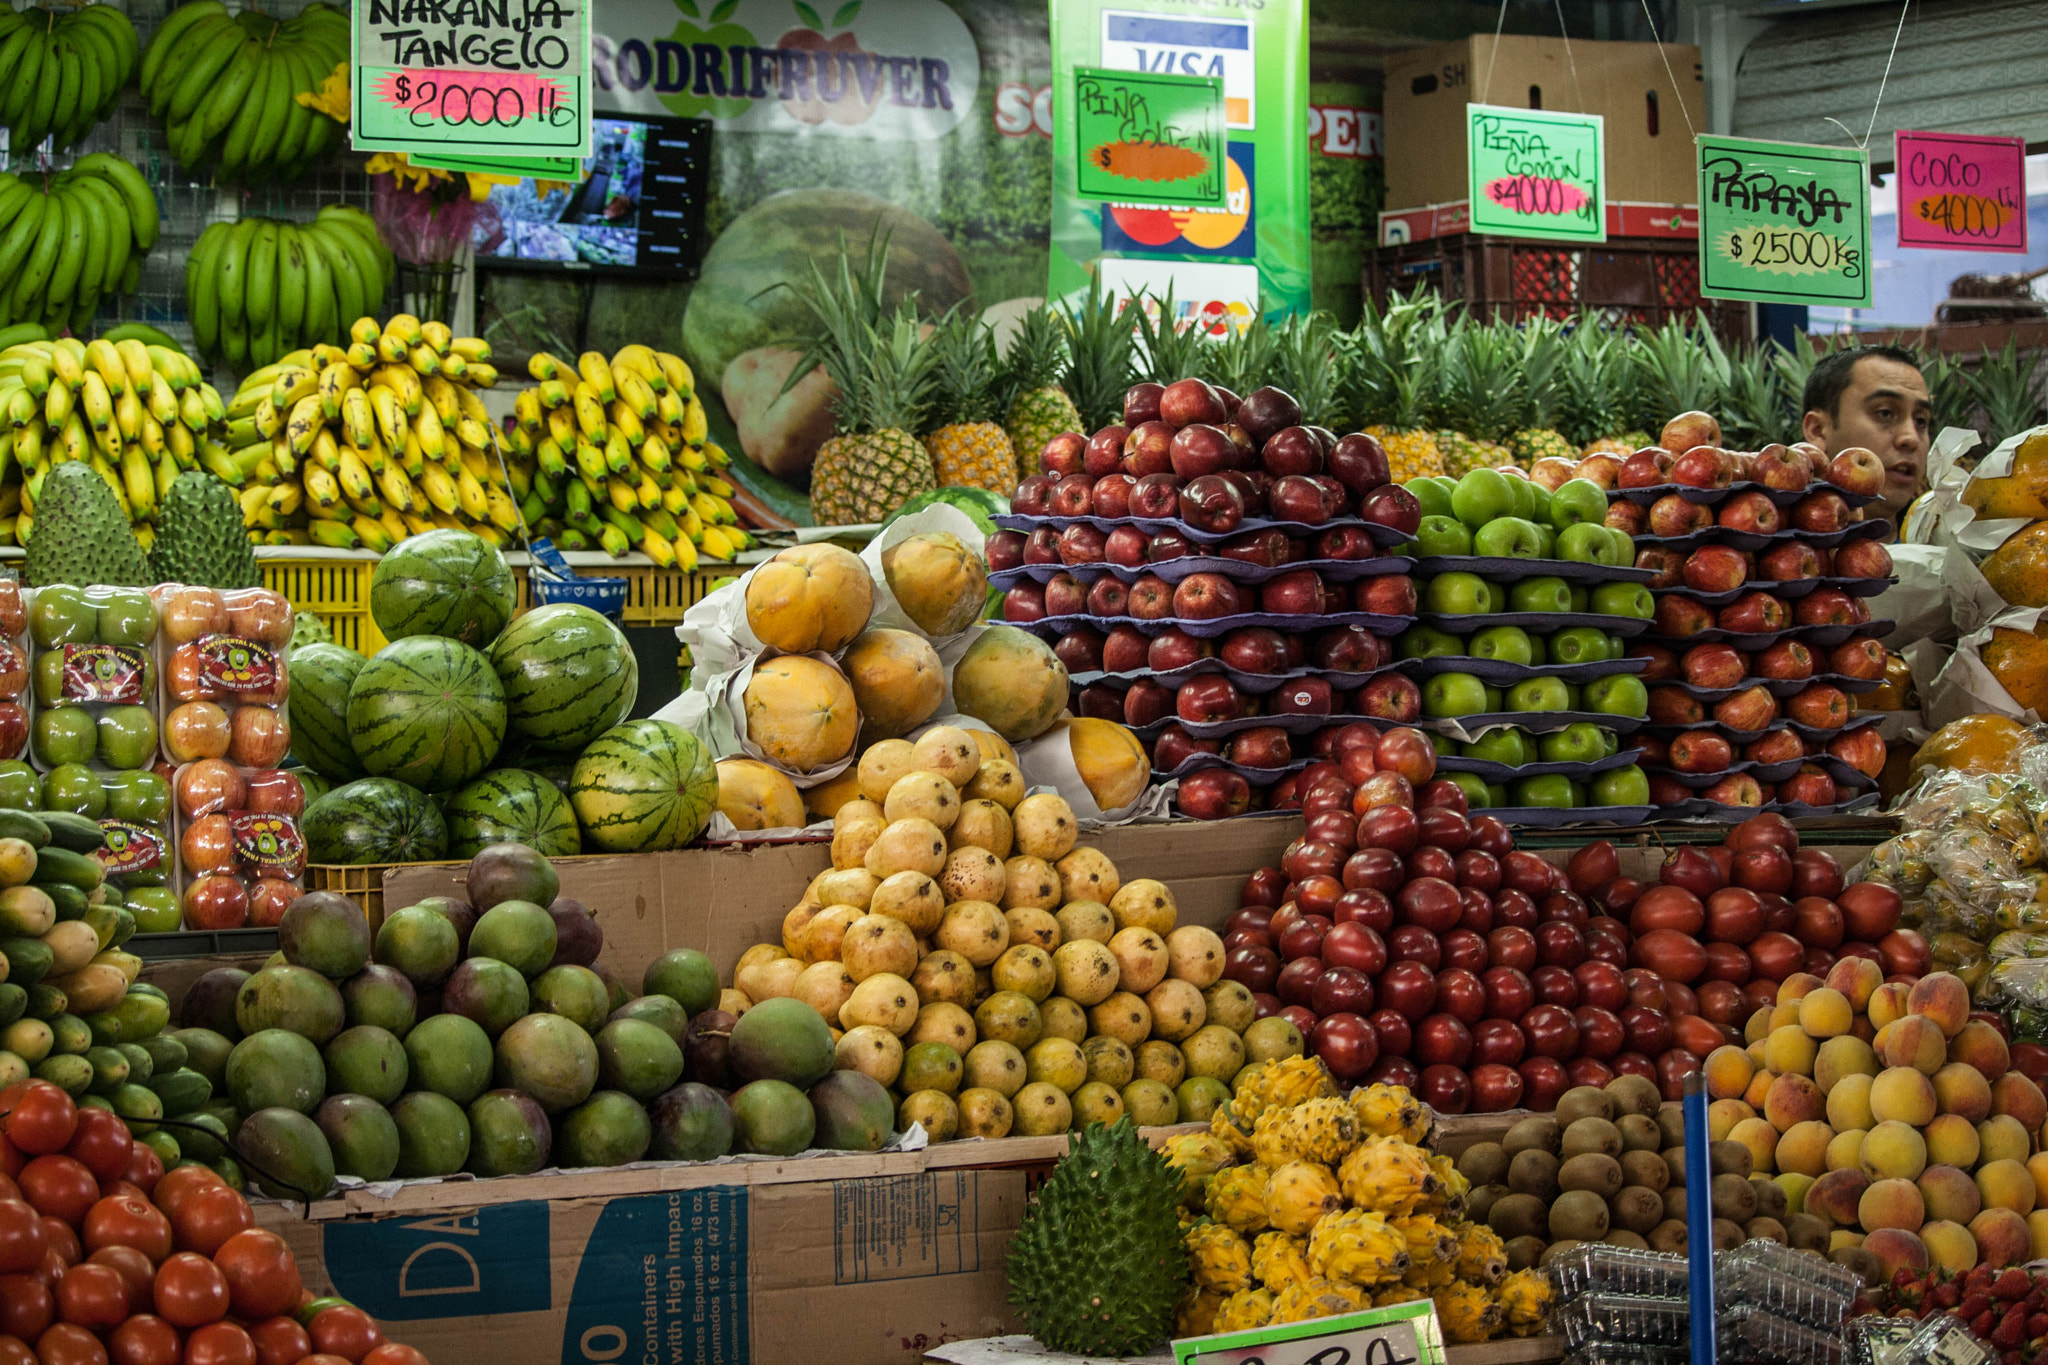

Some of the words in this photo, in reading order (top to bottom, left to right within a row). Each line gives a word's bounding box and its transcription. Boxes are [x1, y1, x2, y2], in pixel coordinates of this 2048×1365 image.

[1134, 47, 1224, 77] VISA
[1910, 151, 1981, 188] COCO
[1702, 157, 1852, 228] PAPAYA
[201, 638, 248, 653] CONTINENTAL
[691, 1216, 703, 1232] 16
[666, 1266, 685, 1314] High
[692, 1237, 706, 1323] Espumados
[709, 1276, 720, 1293] 16
[641, 1254, 660, 1365] Containers
[666, 1320, 683, 1362] with
